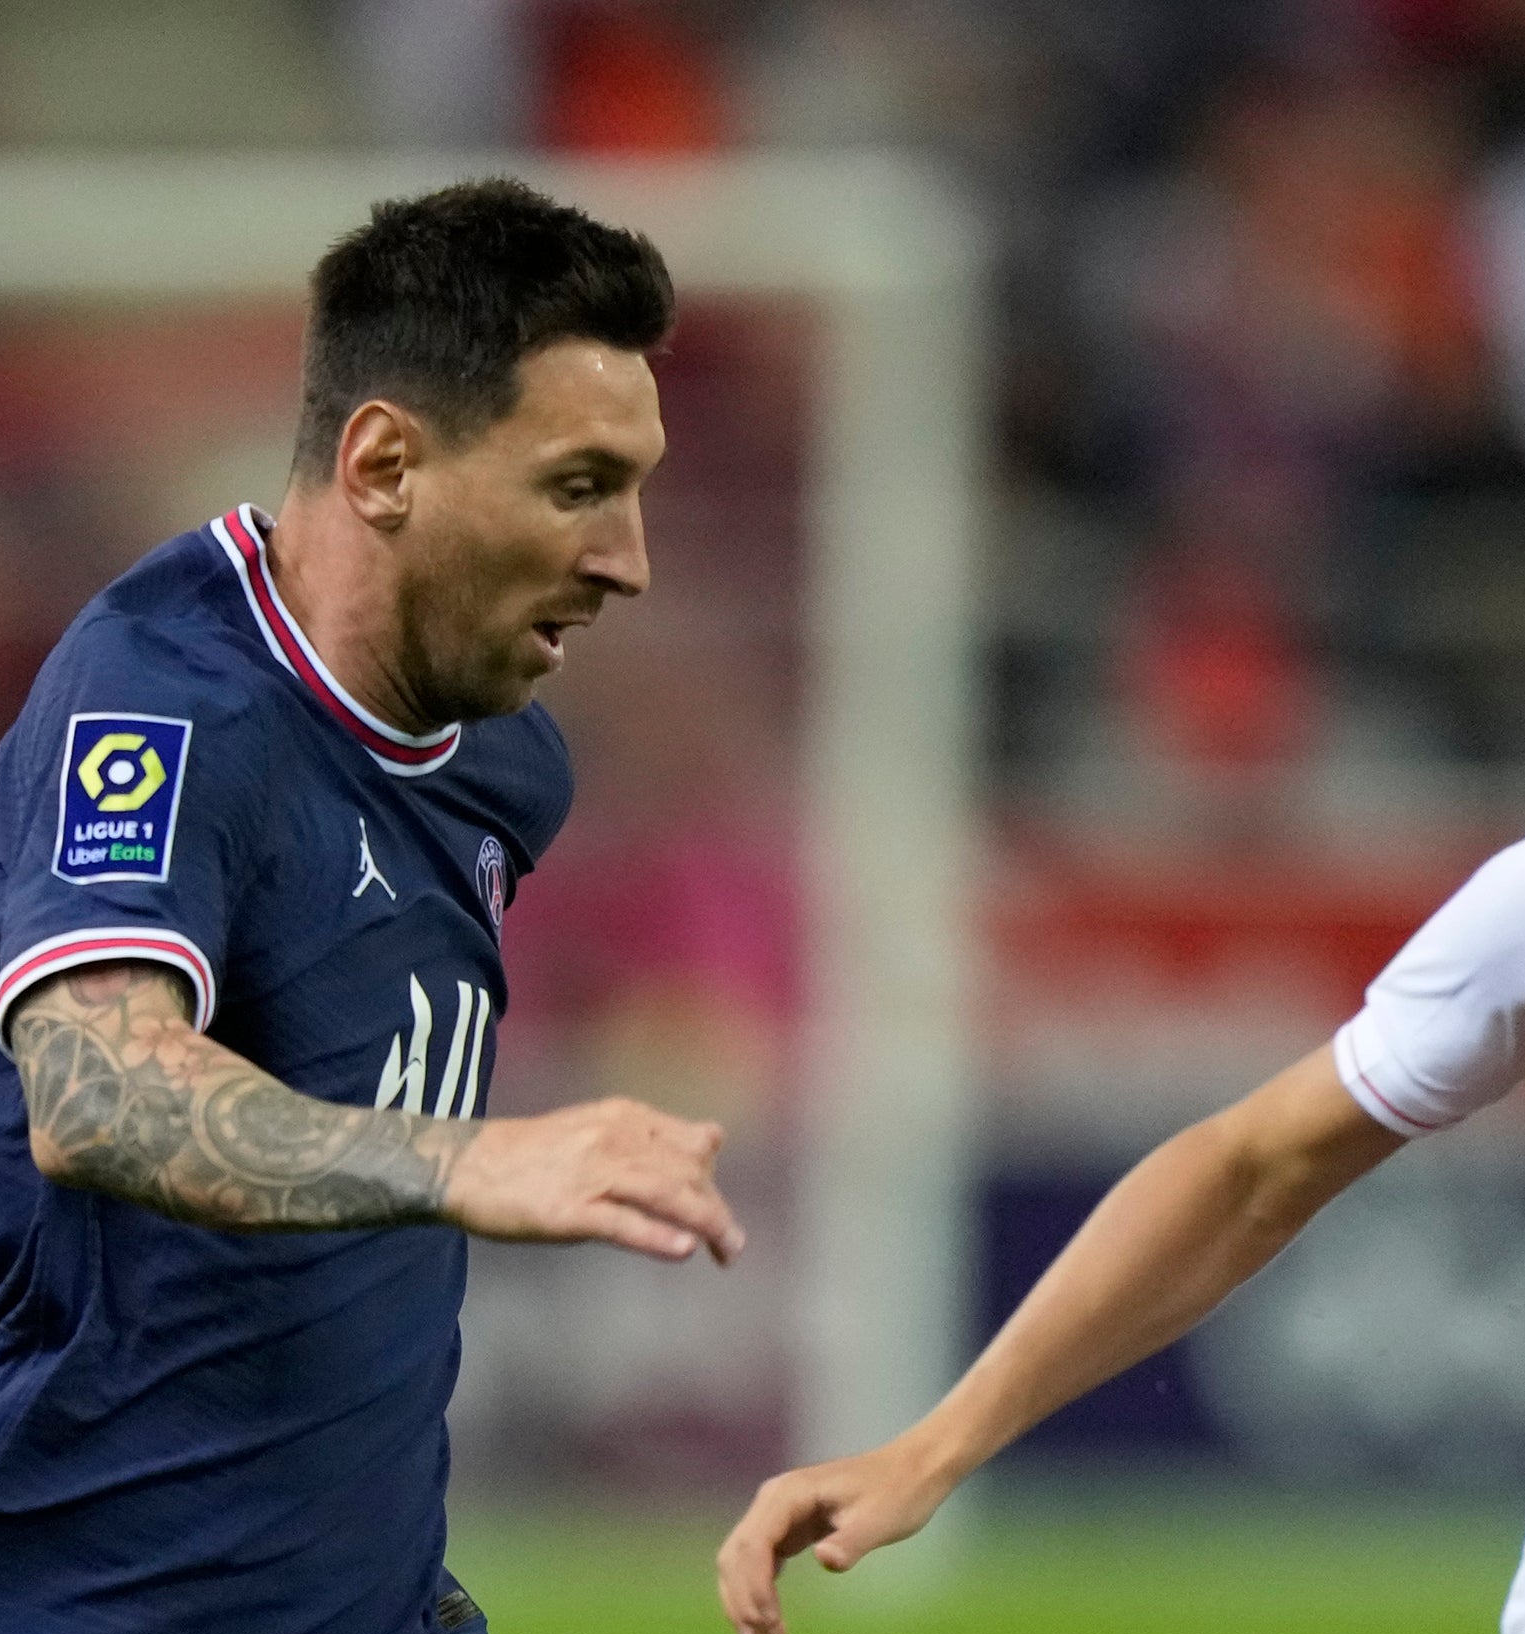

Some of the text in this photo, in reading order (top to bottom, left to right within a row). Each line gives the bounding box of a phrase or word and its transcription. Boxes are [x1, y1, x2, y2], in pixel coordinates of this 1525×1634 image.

[74, 821, 154, 842] LIGUE 1
[67, 842, 155, 866] Uber Eats
